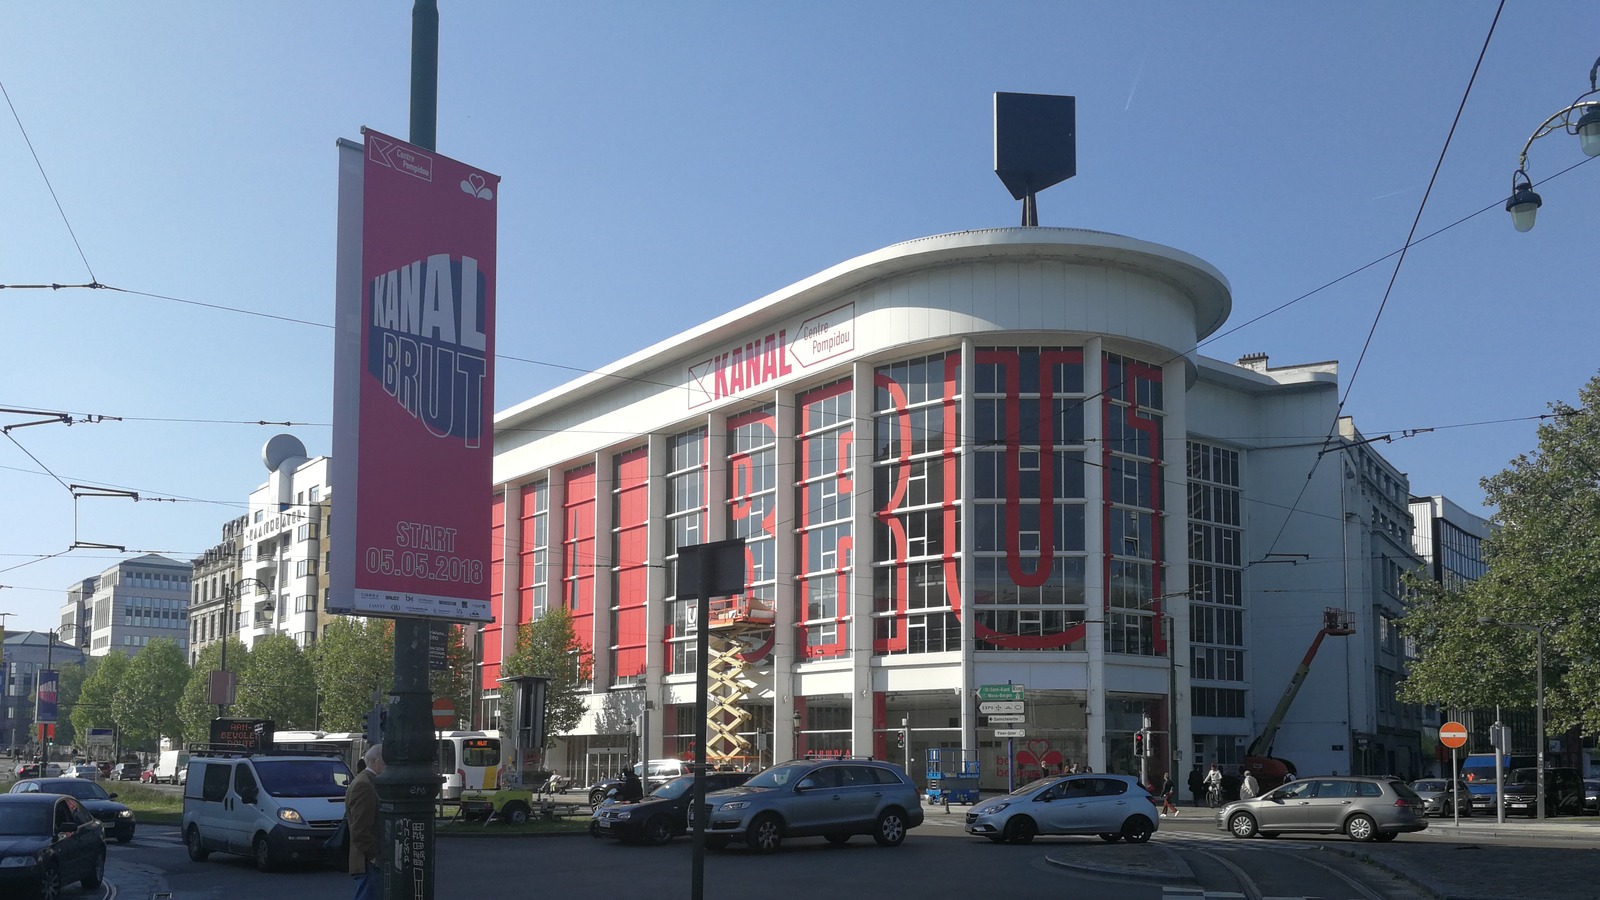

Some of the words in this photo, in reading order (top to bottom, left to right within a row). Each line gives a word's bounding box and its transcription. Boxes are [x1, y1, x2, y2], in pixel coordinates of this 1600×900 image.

[396, 149, 416, 163] Centre
[402, 160, 430, 176] Pompidou
[373, 253, 487, 352] KANAL
[803, 321, 829, 341] Centre
[812, 330, 850, 355] Pompidou
[714, 328, 793, 401] KANAL
[382, 332, 487, 449] BRUT
[396, 520, 457, 553] START
[365, 547, 484, 585] 05.05.2018
